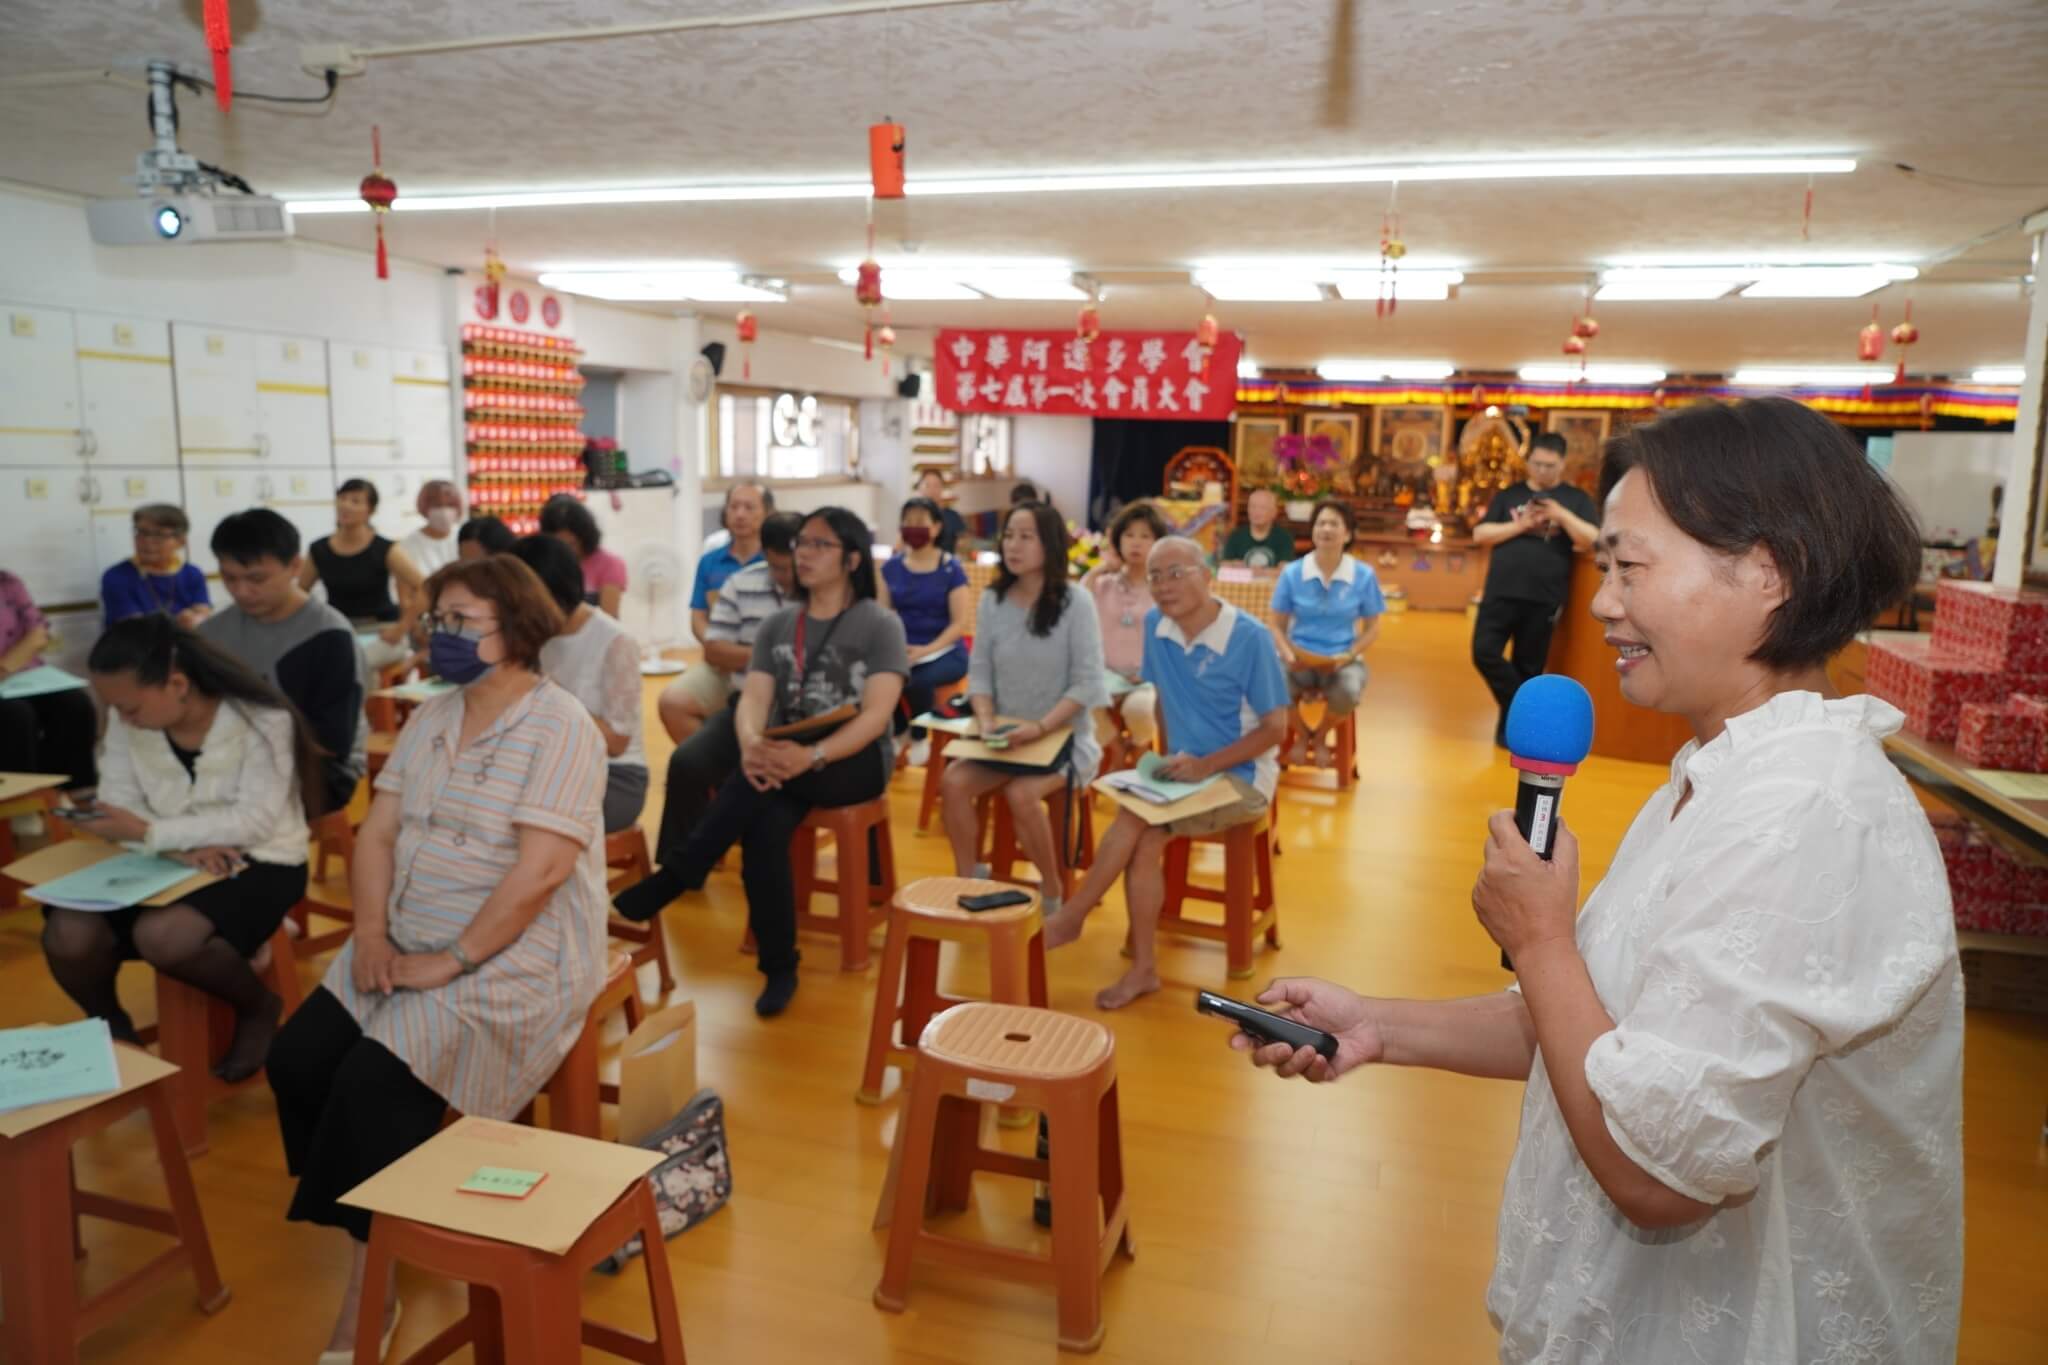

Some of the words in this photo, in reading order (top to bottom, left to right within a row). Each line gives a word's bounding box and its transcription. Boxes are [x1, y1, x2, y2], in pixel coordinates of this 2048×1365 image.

[956, 371, 1209, 412] 第七屆第一次會員大會
